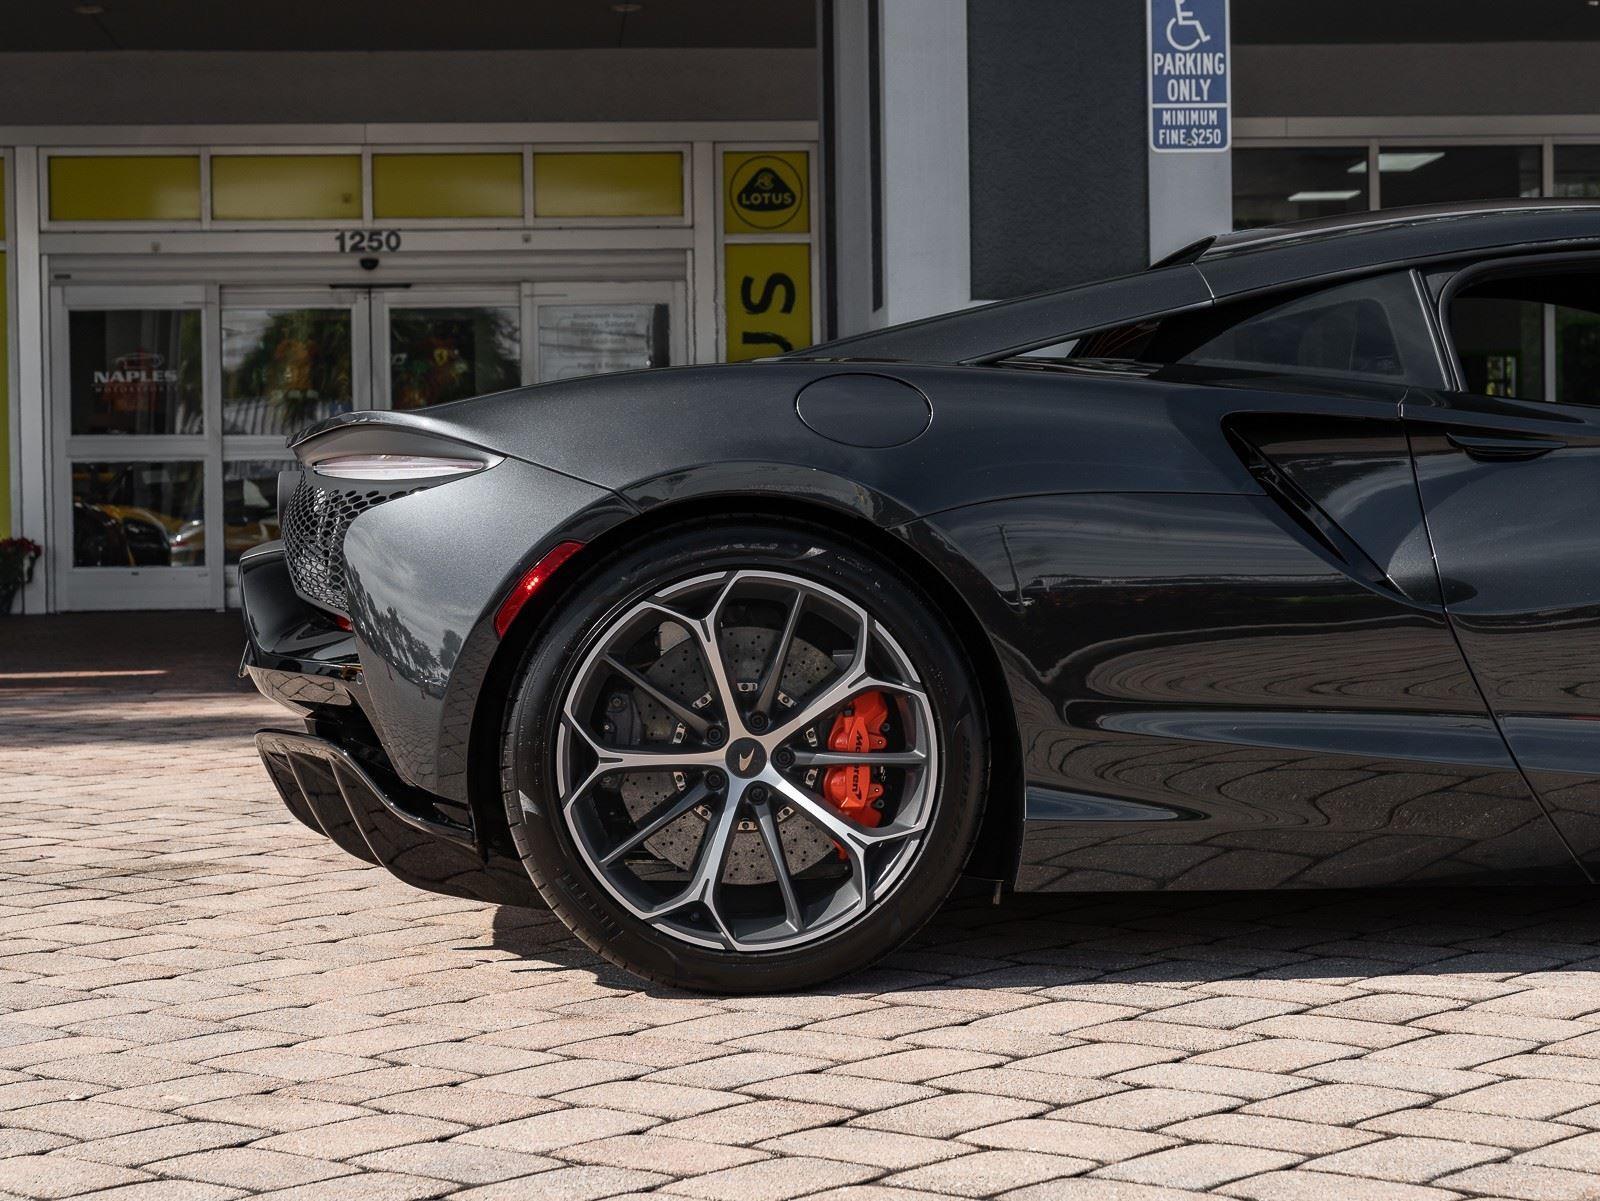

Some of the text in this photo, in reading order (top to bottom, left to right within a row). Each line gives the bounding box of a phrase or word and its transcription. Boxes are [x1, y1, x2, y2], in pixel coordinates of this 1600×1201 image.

[1153, 53, 1225, 75] PARKING
[1167, 79, 1211, 101] ONLY
[1162, 110, 1217, 125] MINIMUM
[1159, 128, 1221, 146] FINE $250
[741, 192, 792, 205] LOTUS
[335, 230, 402, 253] 1250
[94, 370, 177, 383] NAPLES
